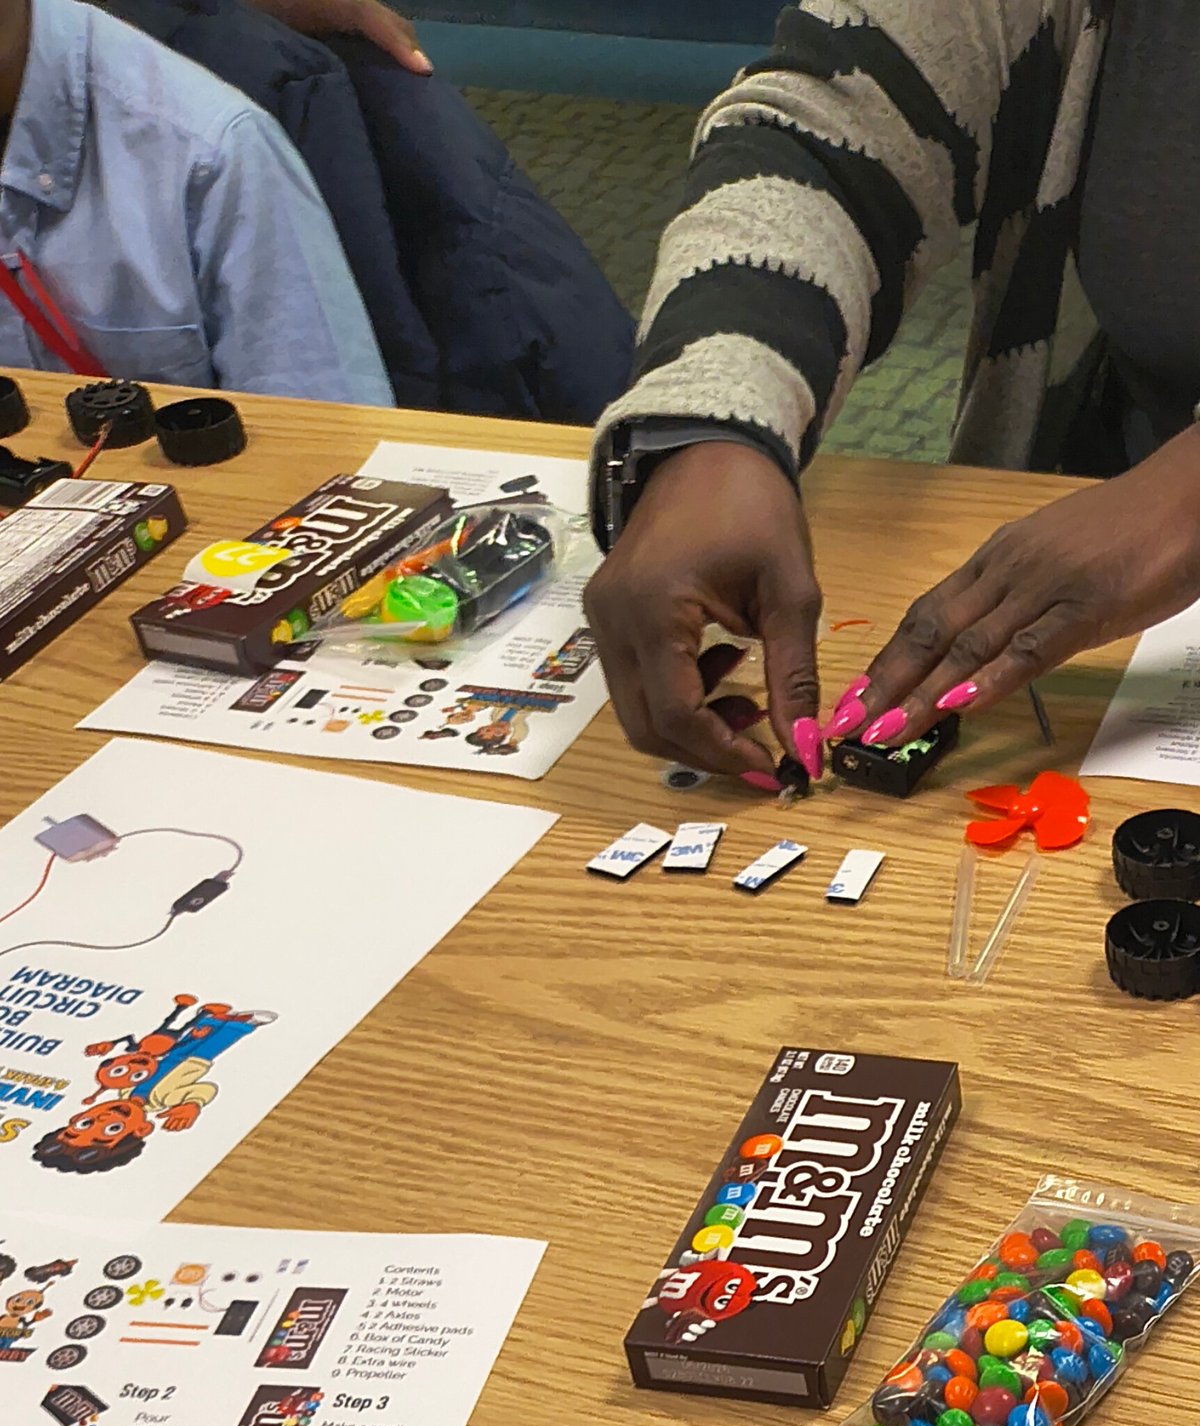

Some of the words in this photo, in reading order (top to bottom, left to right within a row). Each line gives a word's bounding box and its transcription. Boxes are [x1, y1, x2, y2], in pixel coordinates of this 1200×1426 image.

[214, 546, 277, 566] 27
[9, 966, 144, 1005] DIAGRAM
[0, 1027, 63, 1057] BUIL
[776, 1088, 802, 1123] CHOCOLATE
[900, 1101, 931, 1146] milk
[722, 1089, 905, 1304] m&m's
[859, 1144, 910, 1239] chocolate
[384, 1265, 441, 1275] Contents
[401, 1277, 442, 1287] Straws
[386, 1288, 424, 1297] Motor
[380, 1300, 388, 1308] 4
[384, 1311, 421, 1320] Axles
[379, 1322, 438, 1333] Adhesive
[440, 1325, 474, 1336] pads
[364, 1333, 389, 1342] Box
[392, 1334, 406, 1343] of
[408, 1335, 451, 1347] Candy
[356, 1345, 402, 1357] Racing
[403, 1347, 449, 1358] Sticker
[352, 1356, 386, 1367] Extra
[389, 1359, 416, 1368] wire
[346, 1368, 407, 1380] Propeller
[118, 1382, 159, 1402] Step
[161, 1385, 177, 1401] 2
[333, 1393, 373, 1412] Step
[376, 1396, 390, 1410] 3
[135, 1412, 170, 1423] Pour
